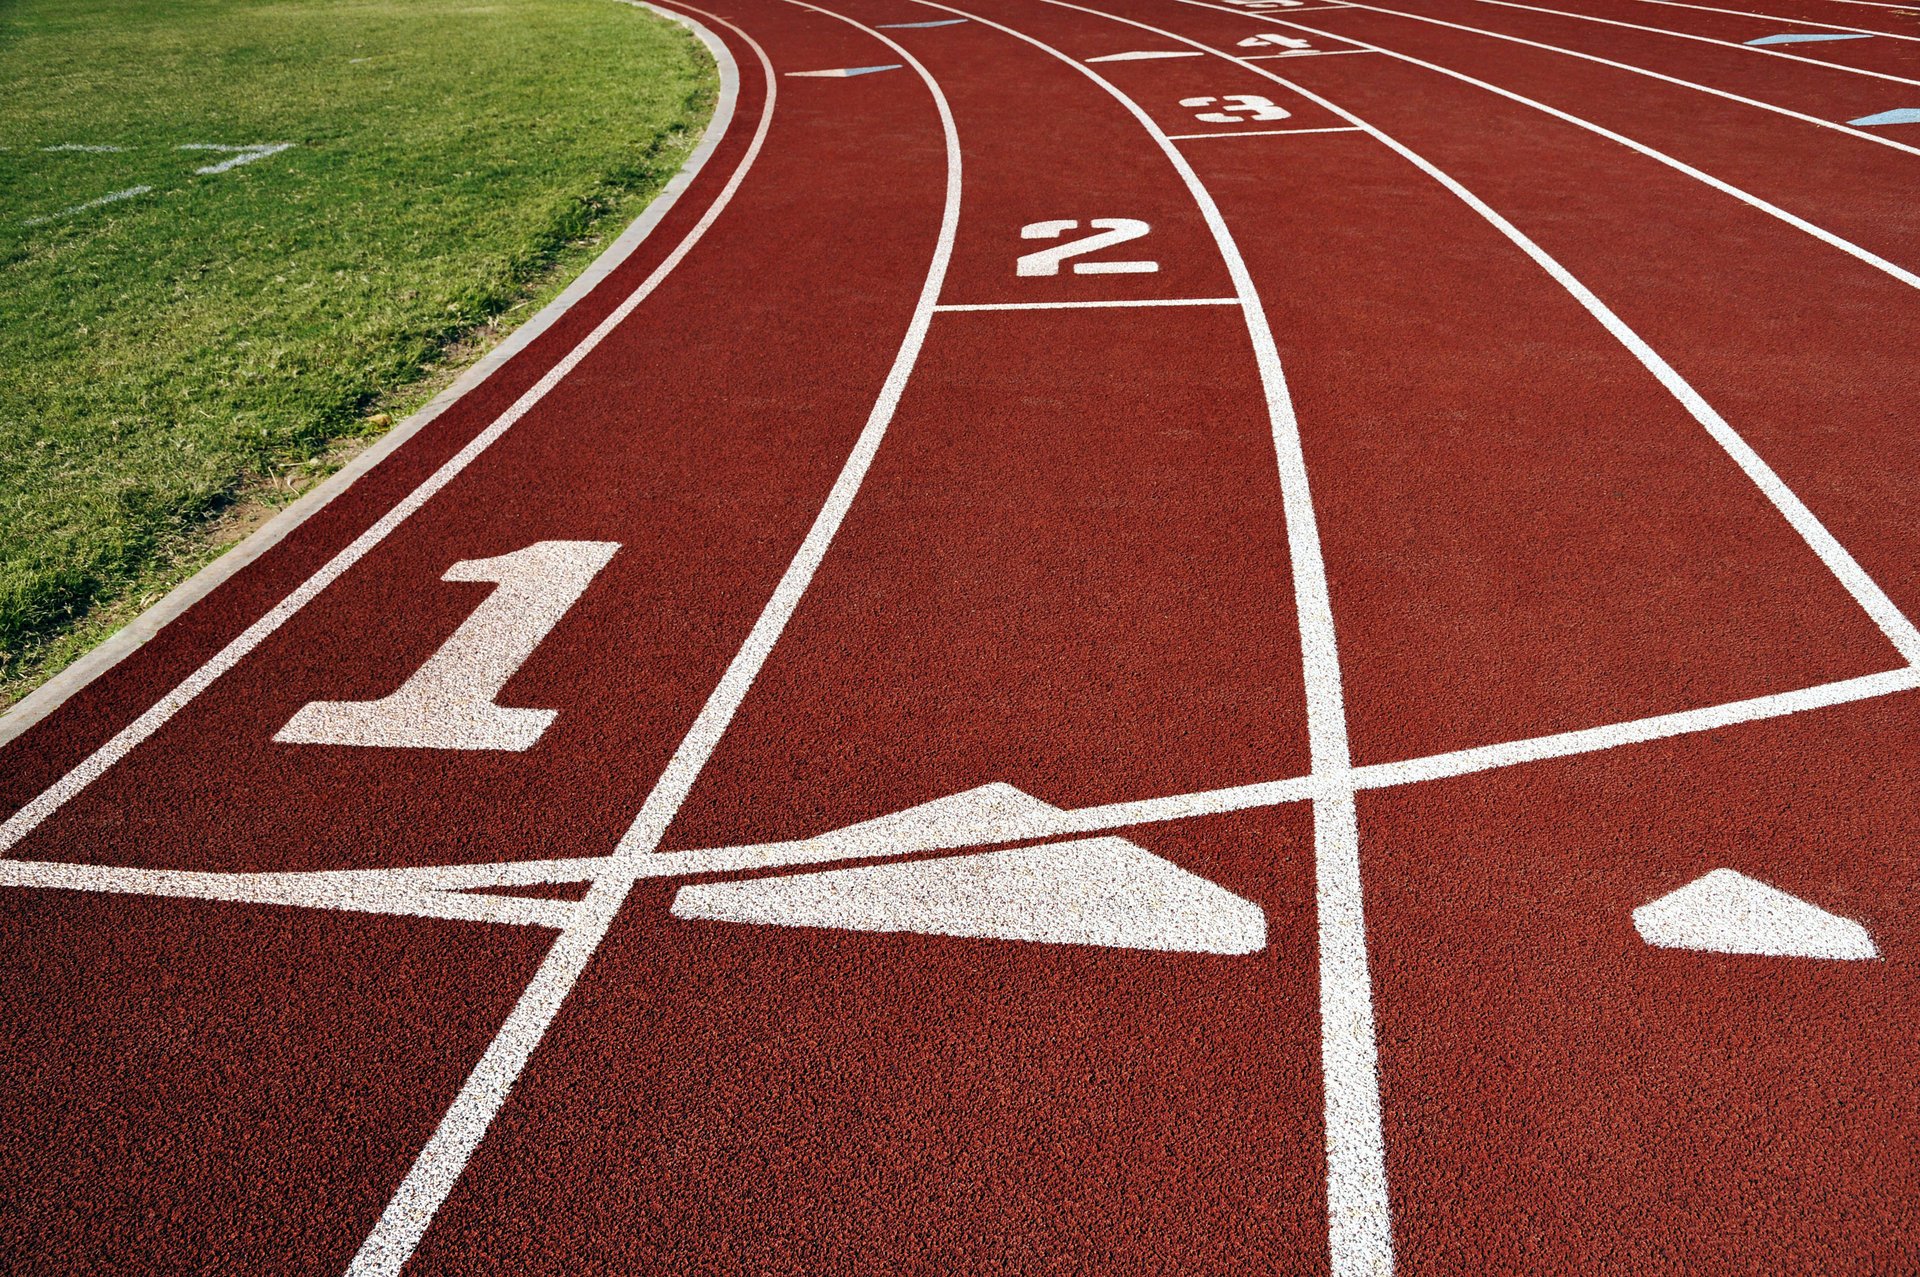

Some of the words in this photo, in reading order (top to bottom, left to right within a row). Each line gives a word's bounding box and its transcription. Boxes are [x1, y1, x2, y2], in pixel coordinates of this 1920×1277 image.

[1237, 33, 1321, 55] 4
[1178, 95, 1291, 123] 3
[1016, 217, 1159, 277] 2
[272, 540, 622, 753] 1
